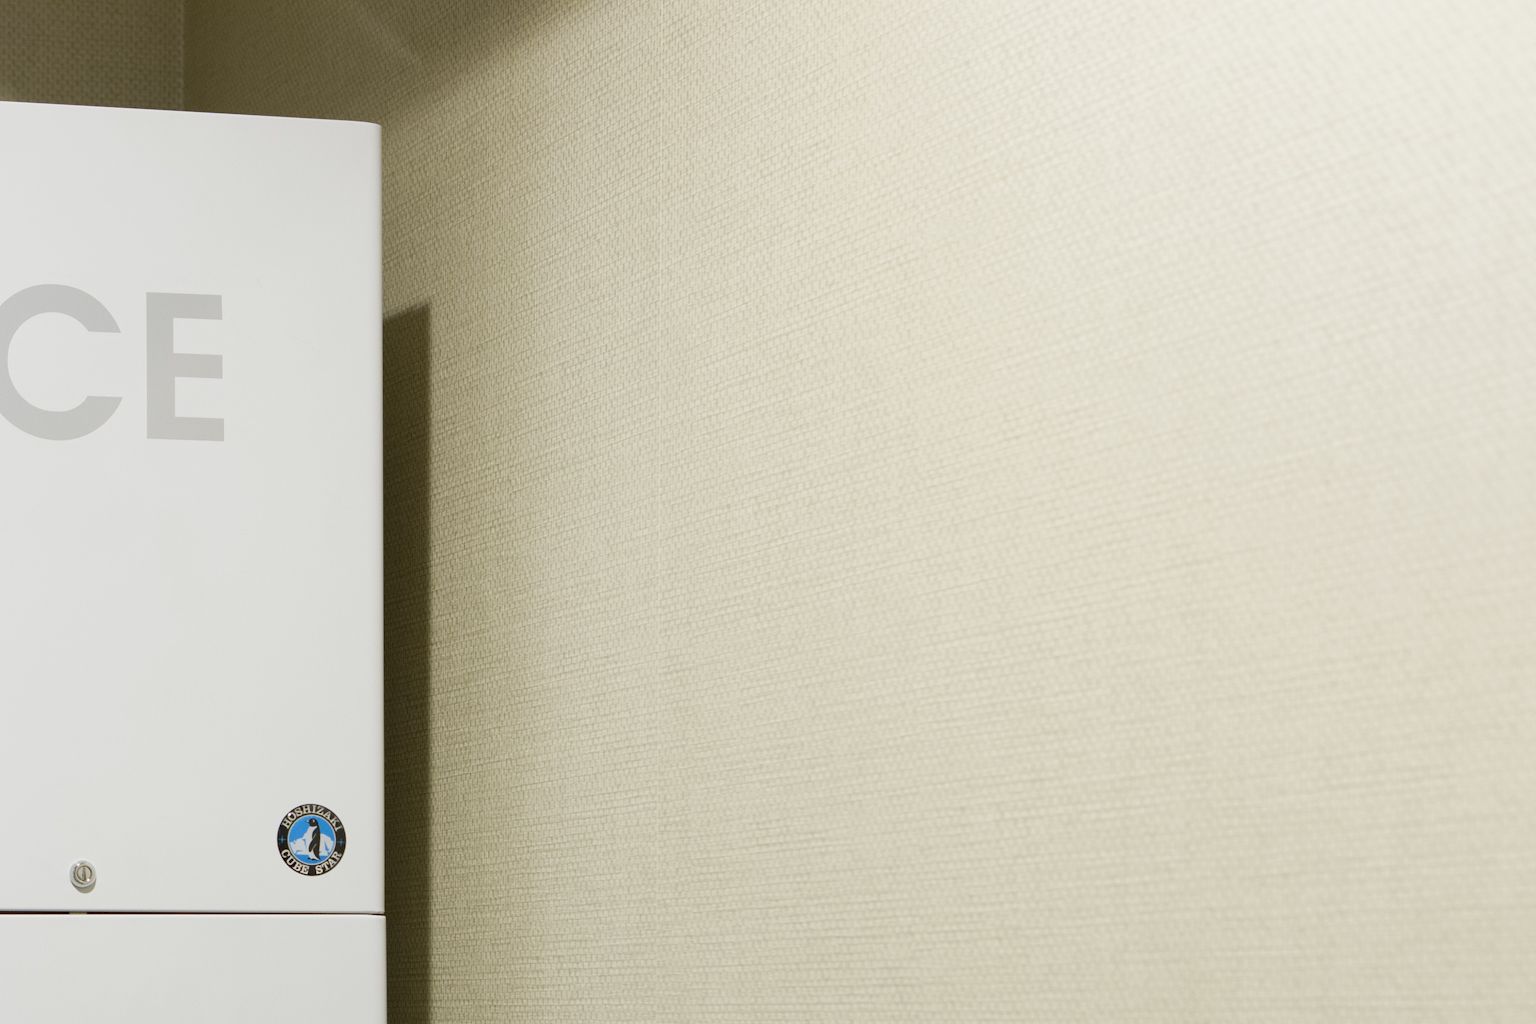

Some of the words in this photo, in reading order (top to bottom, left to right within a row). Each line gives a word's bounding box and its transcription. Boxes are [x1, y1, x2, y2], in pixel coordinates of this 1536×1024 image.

[282, 805, 342, 831] HOSHIZAKI
[281, 848, 310, 875] CUBE
[315, 851, 343, 875] STAR
